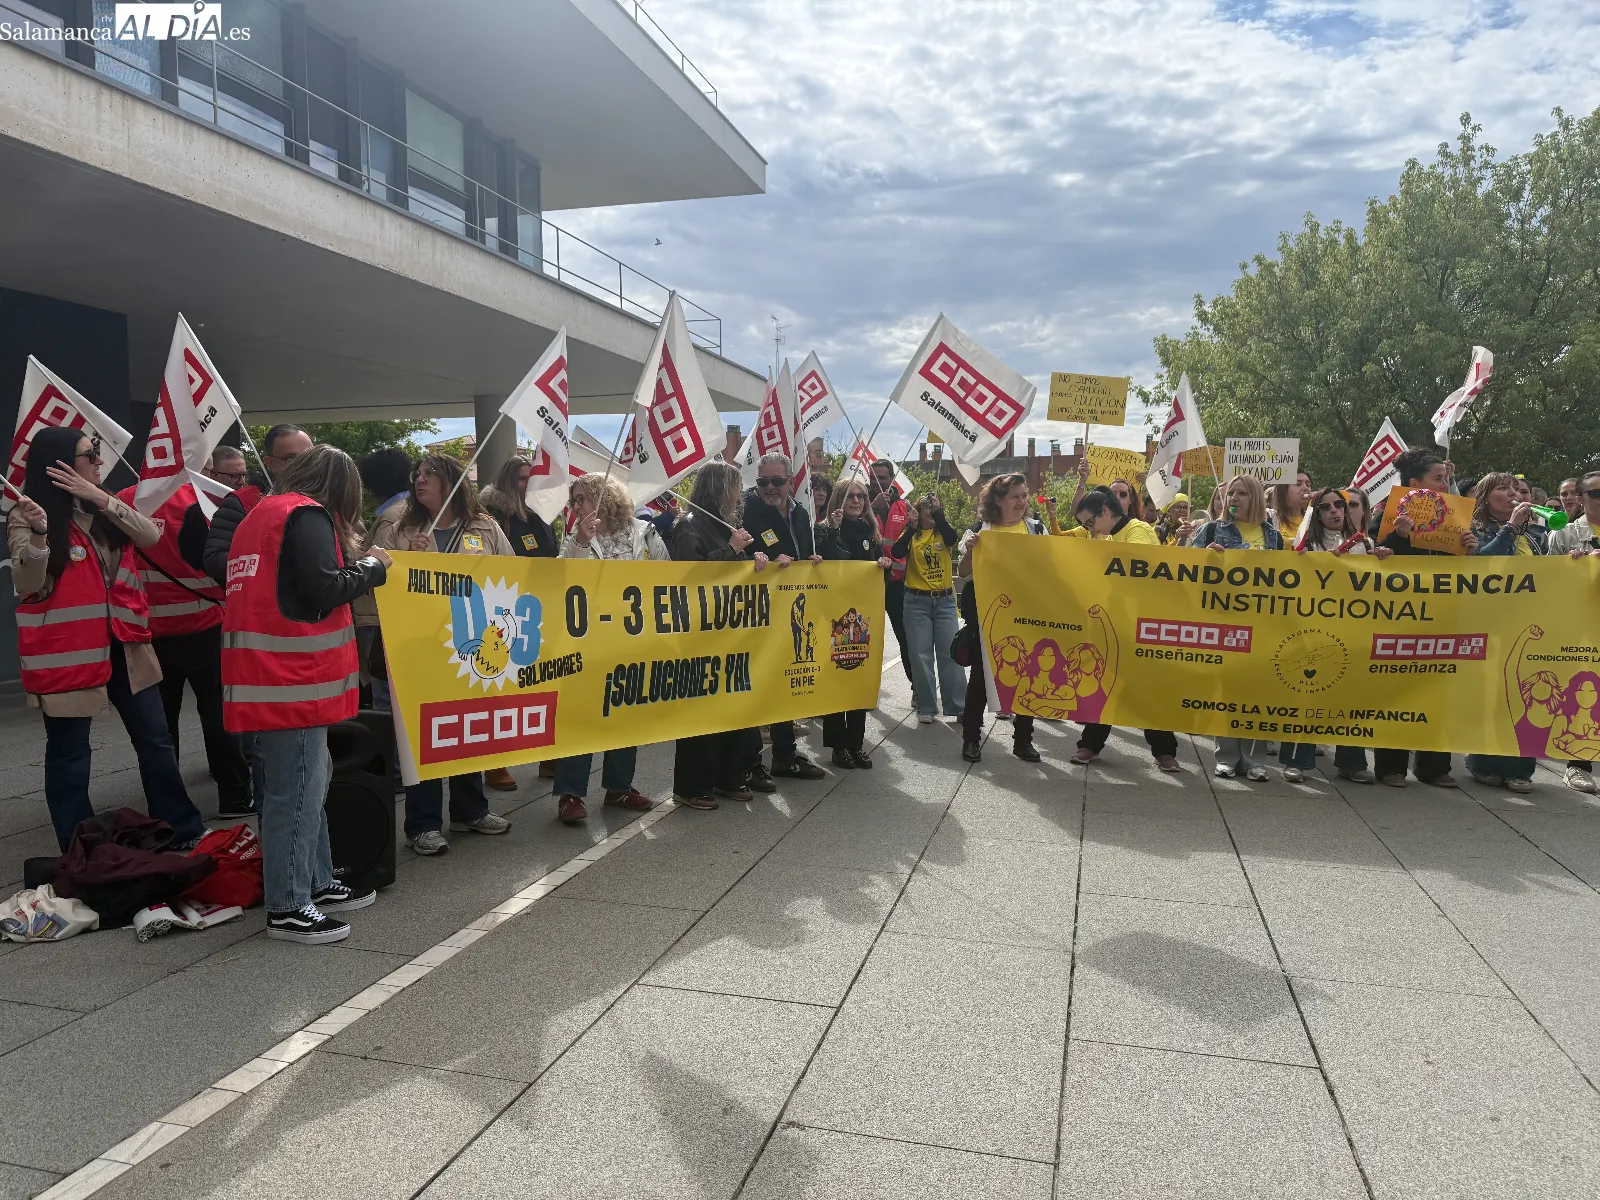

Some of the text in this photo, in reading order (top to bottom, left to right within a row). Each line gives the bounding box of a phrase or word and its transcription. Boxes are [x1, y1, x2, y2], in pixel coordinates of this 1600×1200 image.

[1058, 374, 1071, 383] NO
[930, 352, 1016, 430] CCOO
[919, 391, 979, 444] Salamanca
[1229, 440, 1242, 451] LAS
[1228, 451, 1294, 464] LUCHANDO ESTÁN
[1087, 461, 1140, 484] DUCAMO
[407, 567, 473, 598] MALTRATO
[1104, 557, 1537, 594] ABANDONO Y VIOLENCIA
[565, 584, 589, 638] 0
[622, 586, 644, 636] 3
[653, 585, 690, 634] EN
[697, 583, 771, 632] LUCHA
[1202, 590, 1433, 621] INSTITUCIONAL
[1013, 616, 1083, 631] MENOS RATIOS
[1140, 621, 1220, 646] CCOO
[1274, 628, 1321, 659] PLATAFORMA
[1376, 638, 1456, 655] CCOO
[1560, 646, 1599, 654] MEJORA
[1135, 646, 1223, 665] enseñanza
[1526, 654, 1590, 663] CONDICIONES
[517, 651, 584, 689] SOLUCIONES
[1369, 661, 1457, 675] enseñanza
[790, 675, 815, 689] EN PIE
[1181, 698, 1429, 724] SOMOS LA VOZ DE LA INFANCIA
[431, 704, 548, 749] CCOO
[1230, 720, 1374, 738] 0-3 ES EDUCACIÓN
